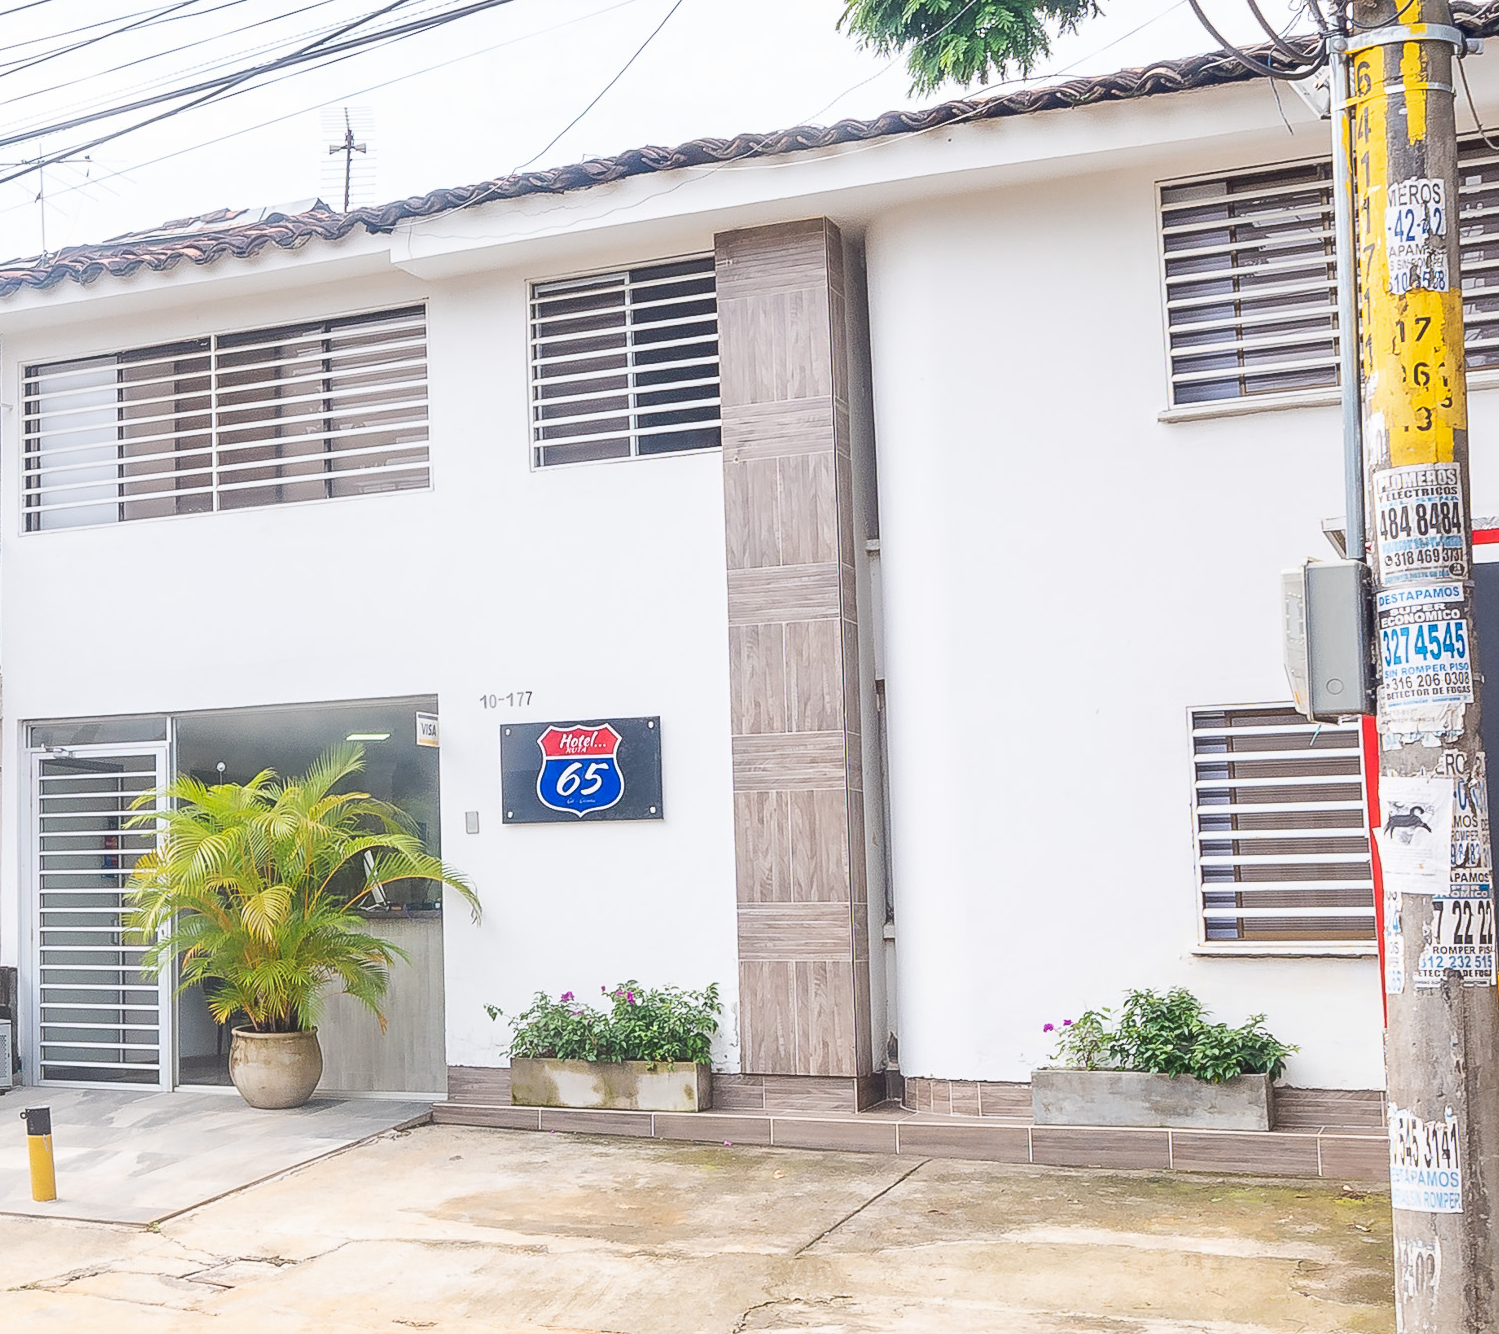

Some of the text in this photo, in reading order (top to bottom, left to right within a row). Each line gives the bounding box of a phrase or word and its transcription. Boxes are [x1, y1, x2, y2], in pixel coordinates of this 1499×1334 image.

[1380, 501, 1461, 541] 484 8484
[1394, 550, 1415, 567] 318
[1417, 548, 1440, 565] 469
[1379, 586, 1460, 607] DESTAPAMOS
[1381, 608, 1461, 629] ECONOMICO
[1389, 603, 1447, 617] SUPER
[1383, 621, 1466, 667] 327 4545
[1385, 662, 1469, 679] SIN ROMPER PISO
[1392, 676, 1413, 691] 316
[1417, 673, 1441, 688] 206
[479, 691, 533, 709] 10-177
[1387, 685, 1471, 701] DETECTOR DE FUGAS
[420, 722, 437, 737] VISA
[556, 761, 610, 797] 65
[1452, 900, 1474, 945] 22
[1433, 945, 1476, 955] ROMPER
[1448, 955, 1472, 968] 232
